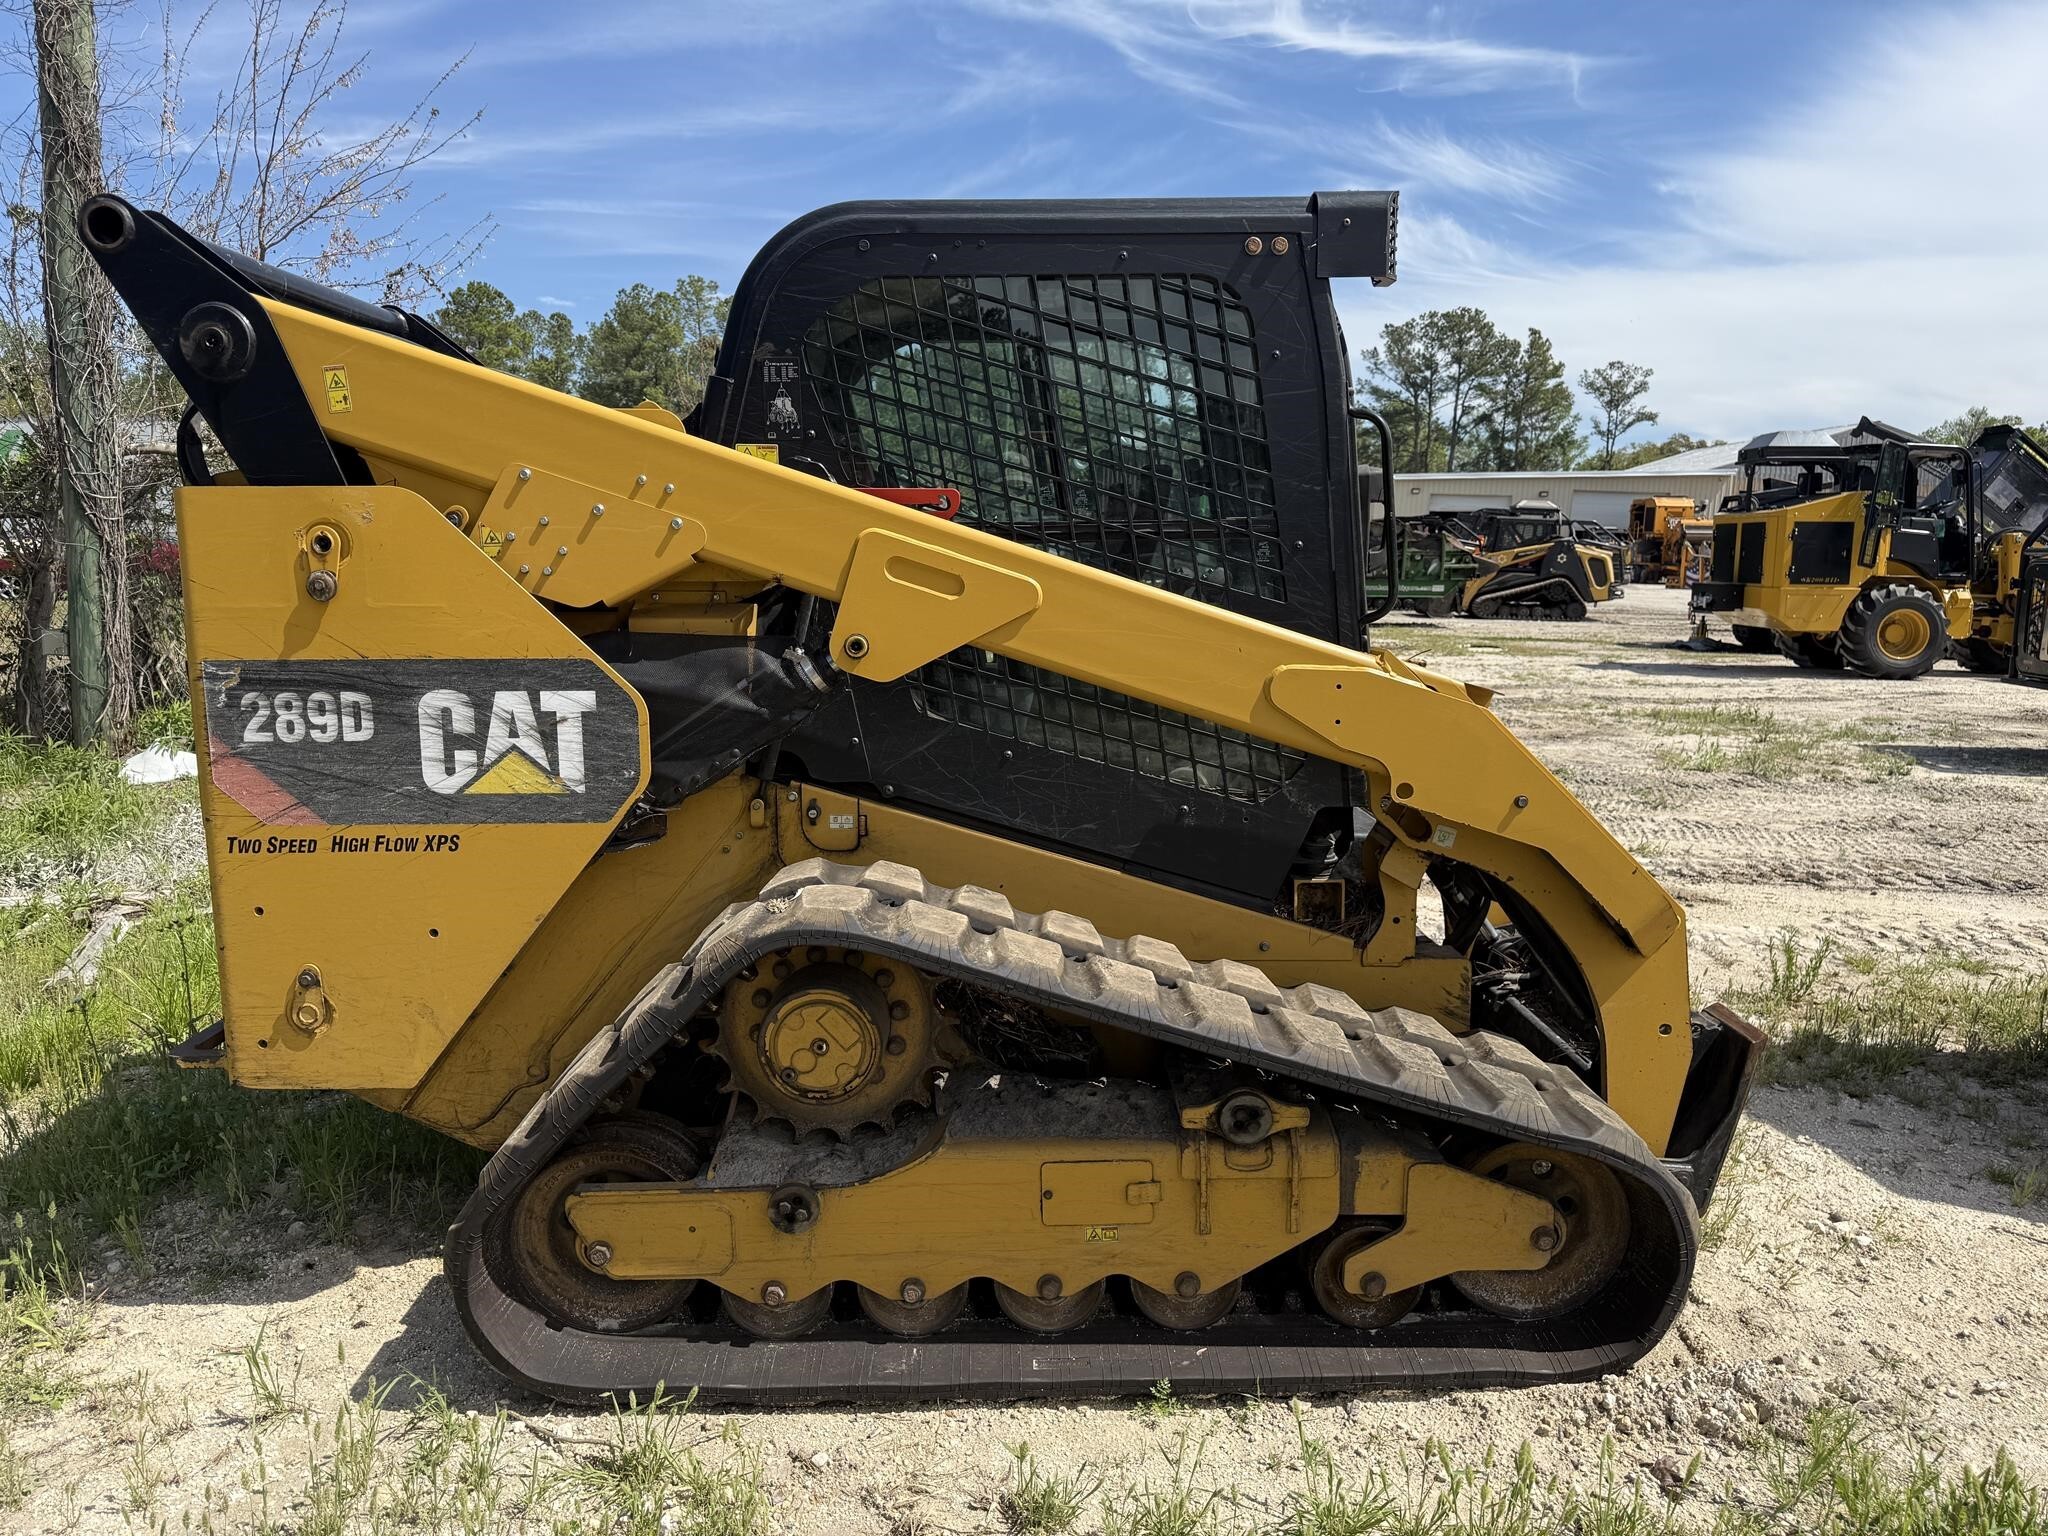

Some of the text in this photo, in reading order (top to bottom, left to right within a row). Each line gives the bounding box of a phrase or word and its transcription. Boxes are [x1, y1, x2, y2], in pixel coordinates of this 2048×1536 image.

[240, 691, 375, 744] 289D
[418, 689, 597, 795] CAT
[423, 834, 460, 852] XPS
